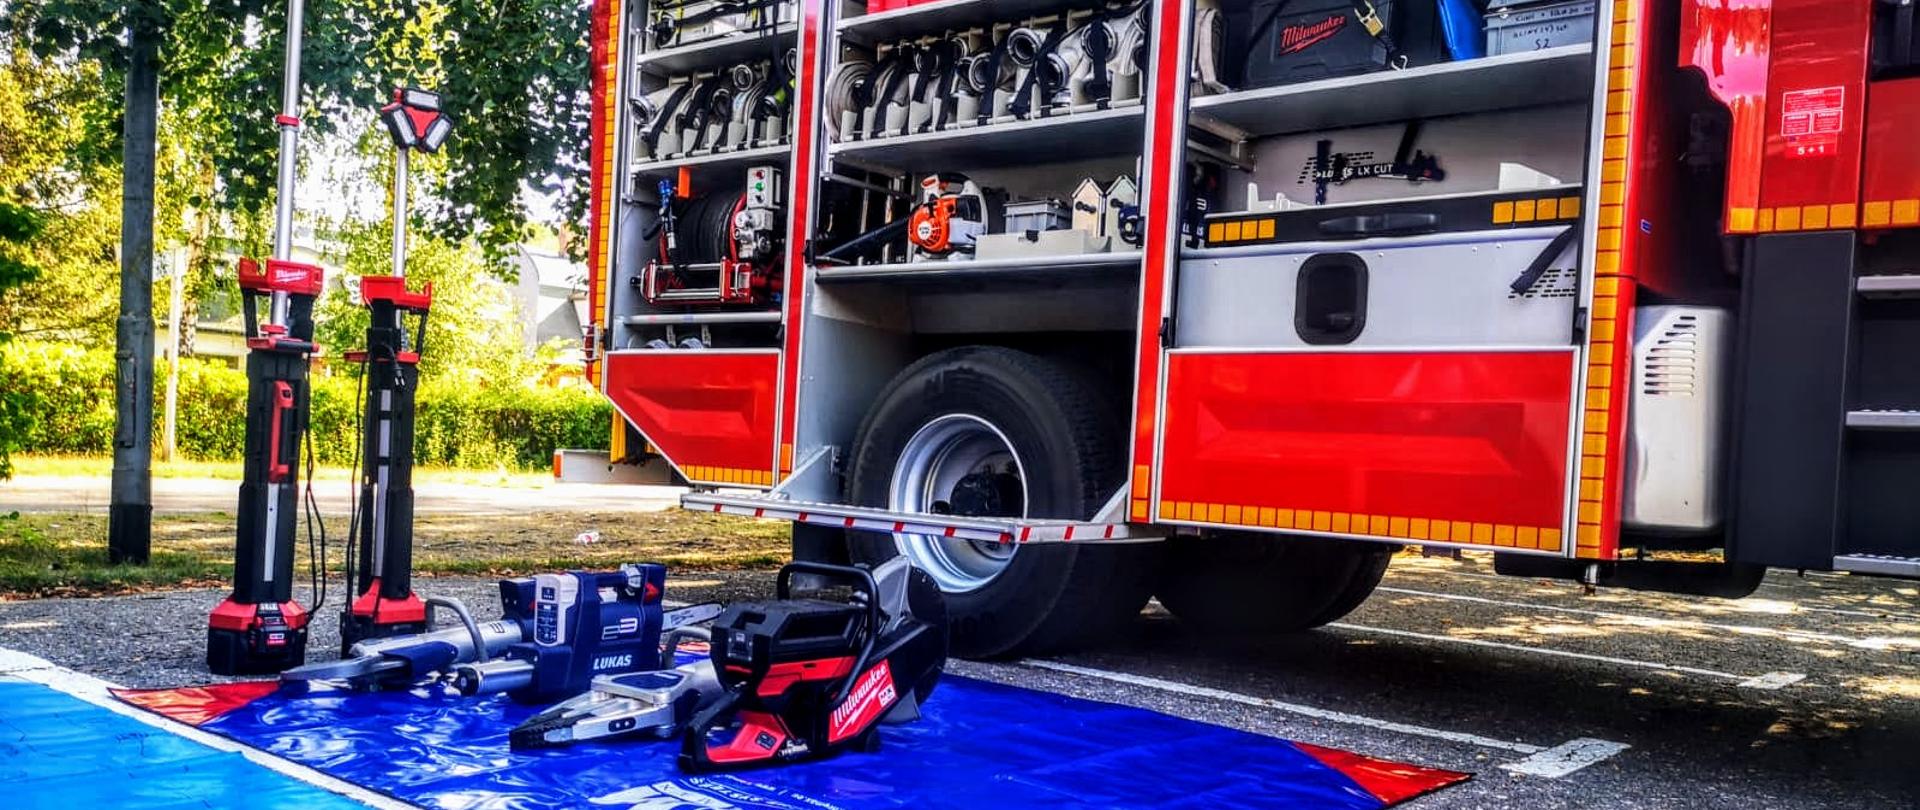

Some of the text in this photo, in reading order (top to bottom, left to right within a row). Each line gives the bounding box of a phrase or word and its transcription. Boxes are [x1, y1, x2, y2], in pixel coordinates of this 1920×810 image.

[1281, 16, 1345, 48] Milwaukee
[1357, 166, 1370, 176] LX
[1373, 163, 1394, 174] CUT
[593, 654, 632, 670] LUKAS
[833, 663, 887, 728] Milwaukee
